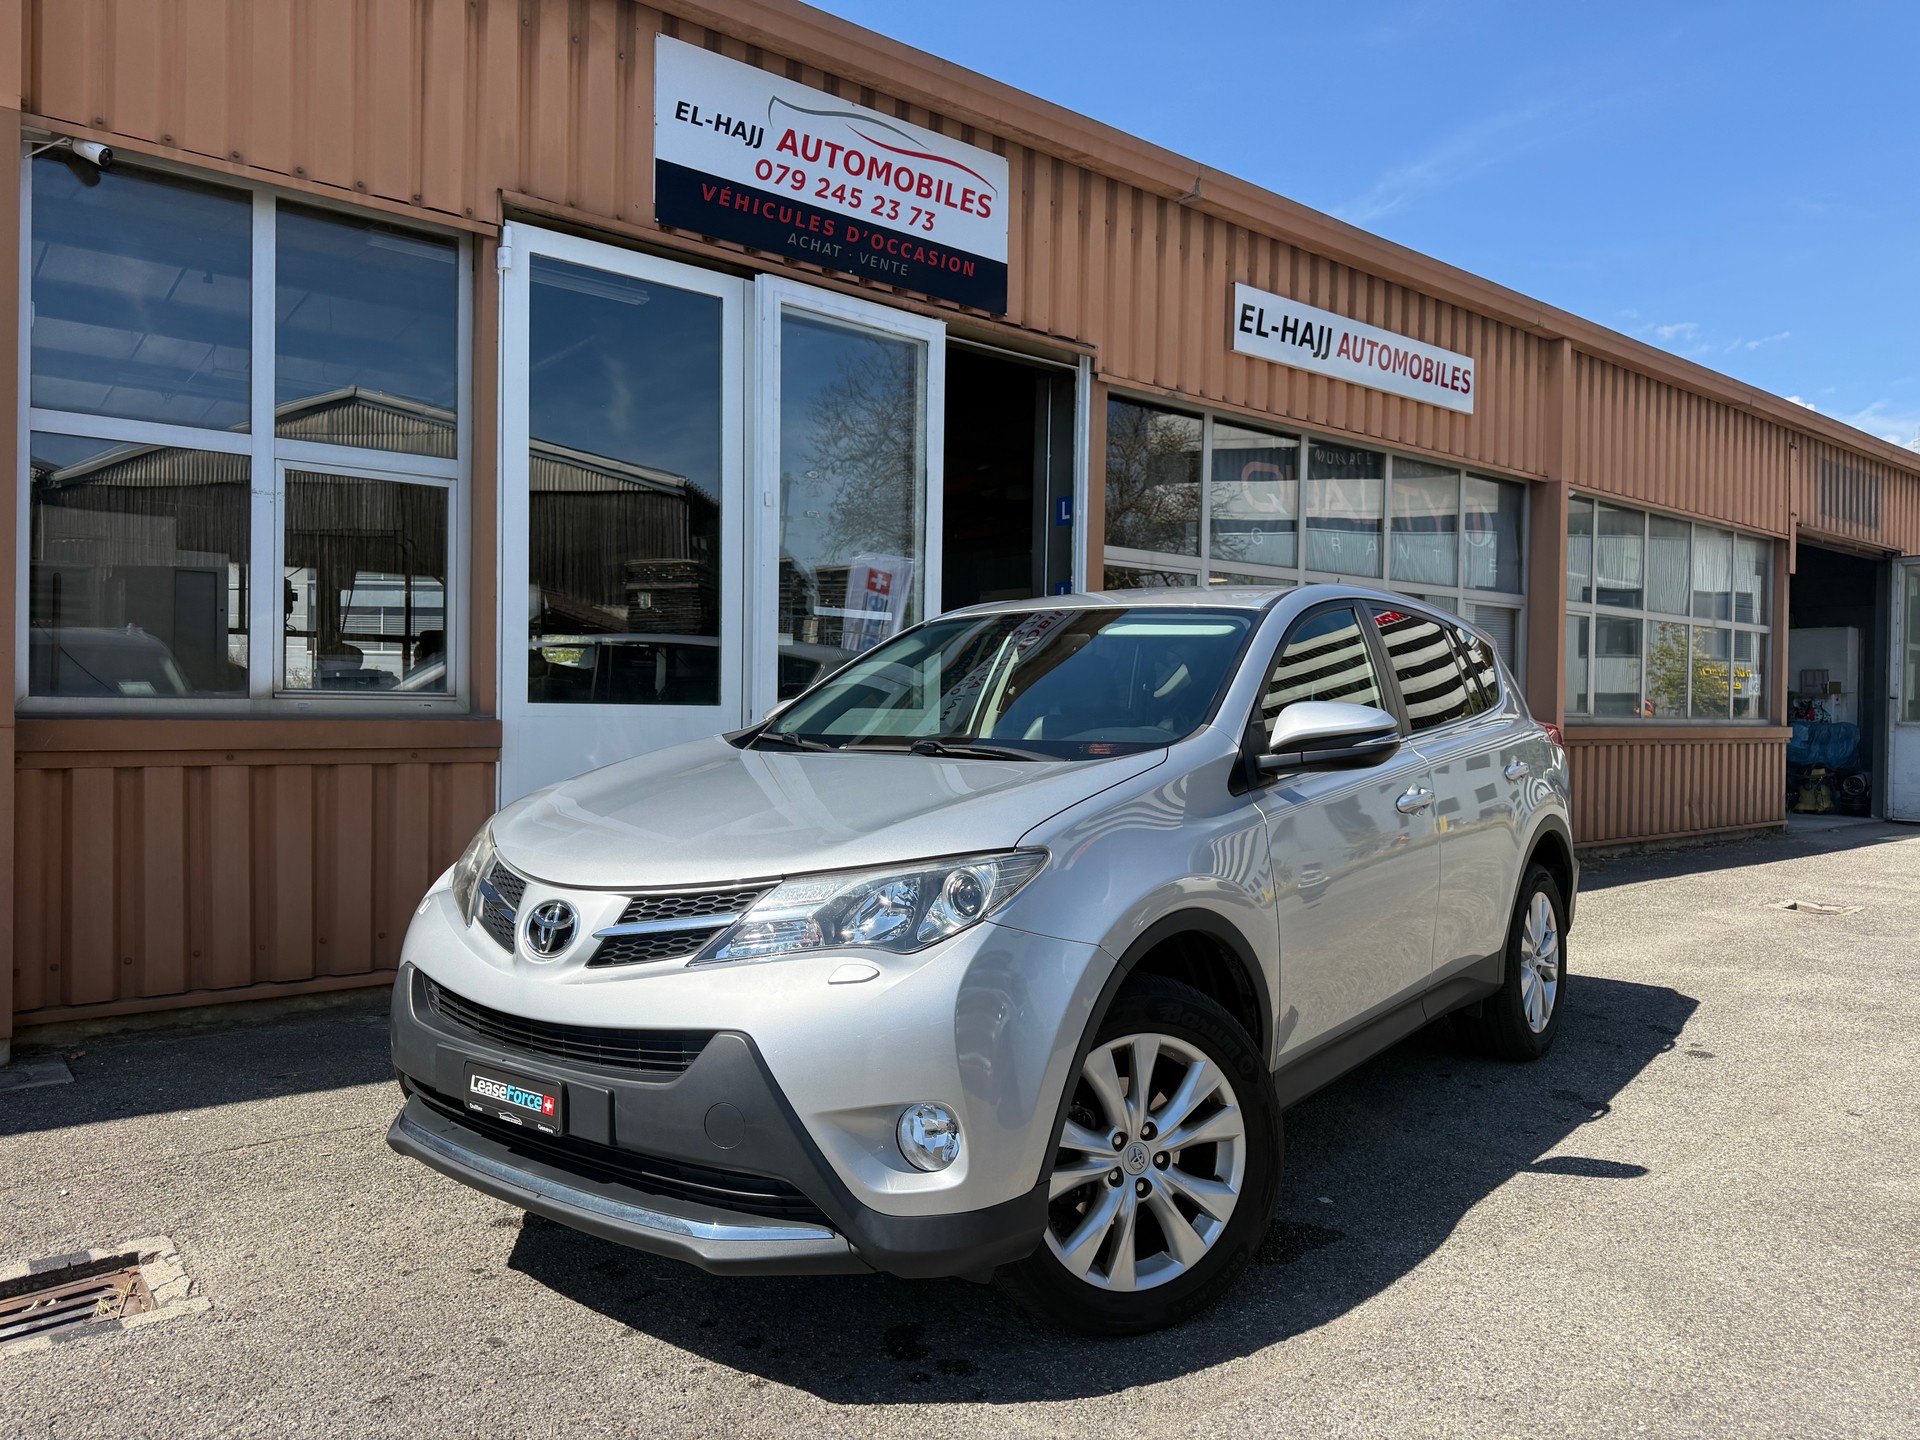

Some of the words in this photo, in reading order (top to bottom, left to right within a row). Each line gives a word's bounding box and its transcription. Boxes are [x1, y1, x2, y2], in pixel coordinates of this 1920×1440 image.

[675, 100, 765, 149] EL-HAJJ
[776, 128, 993, 219] AUTOMOBILES
[755, 159, 806, 192] 079
[815, 177, 863, 209] 245
[870, 195, 900, 221] 23
[909, 206, 937, 232] 73
[702, 182, 835, 236] VÉHICULES
[846, 225, 976, 277] D'OCCASION
[787, 232, 842, 258] ACHAT
[859, 252, 909, 277] VENTE
[1239, 304, 1332, 360] EL-HAJJ
[1337, 332, 1471, 395] AUTOMOBILES
[1241, 461, 1449, 533] QUALTY
[470, 1074, 542, 1109] LeaseForce
